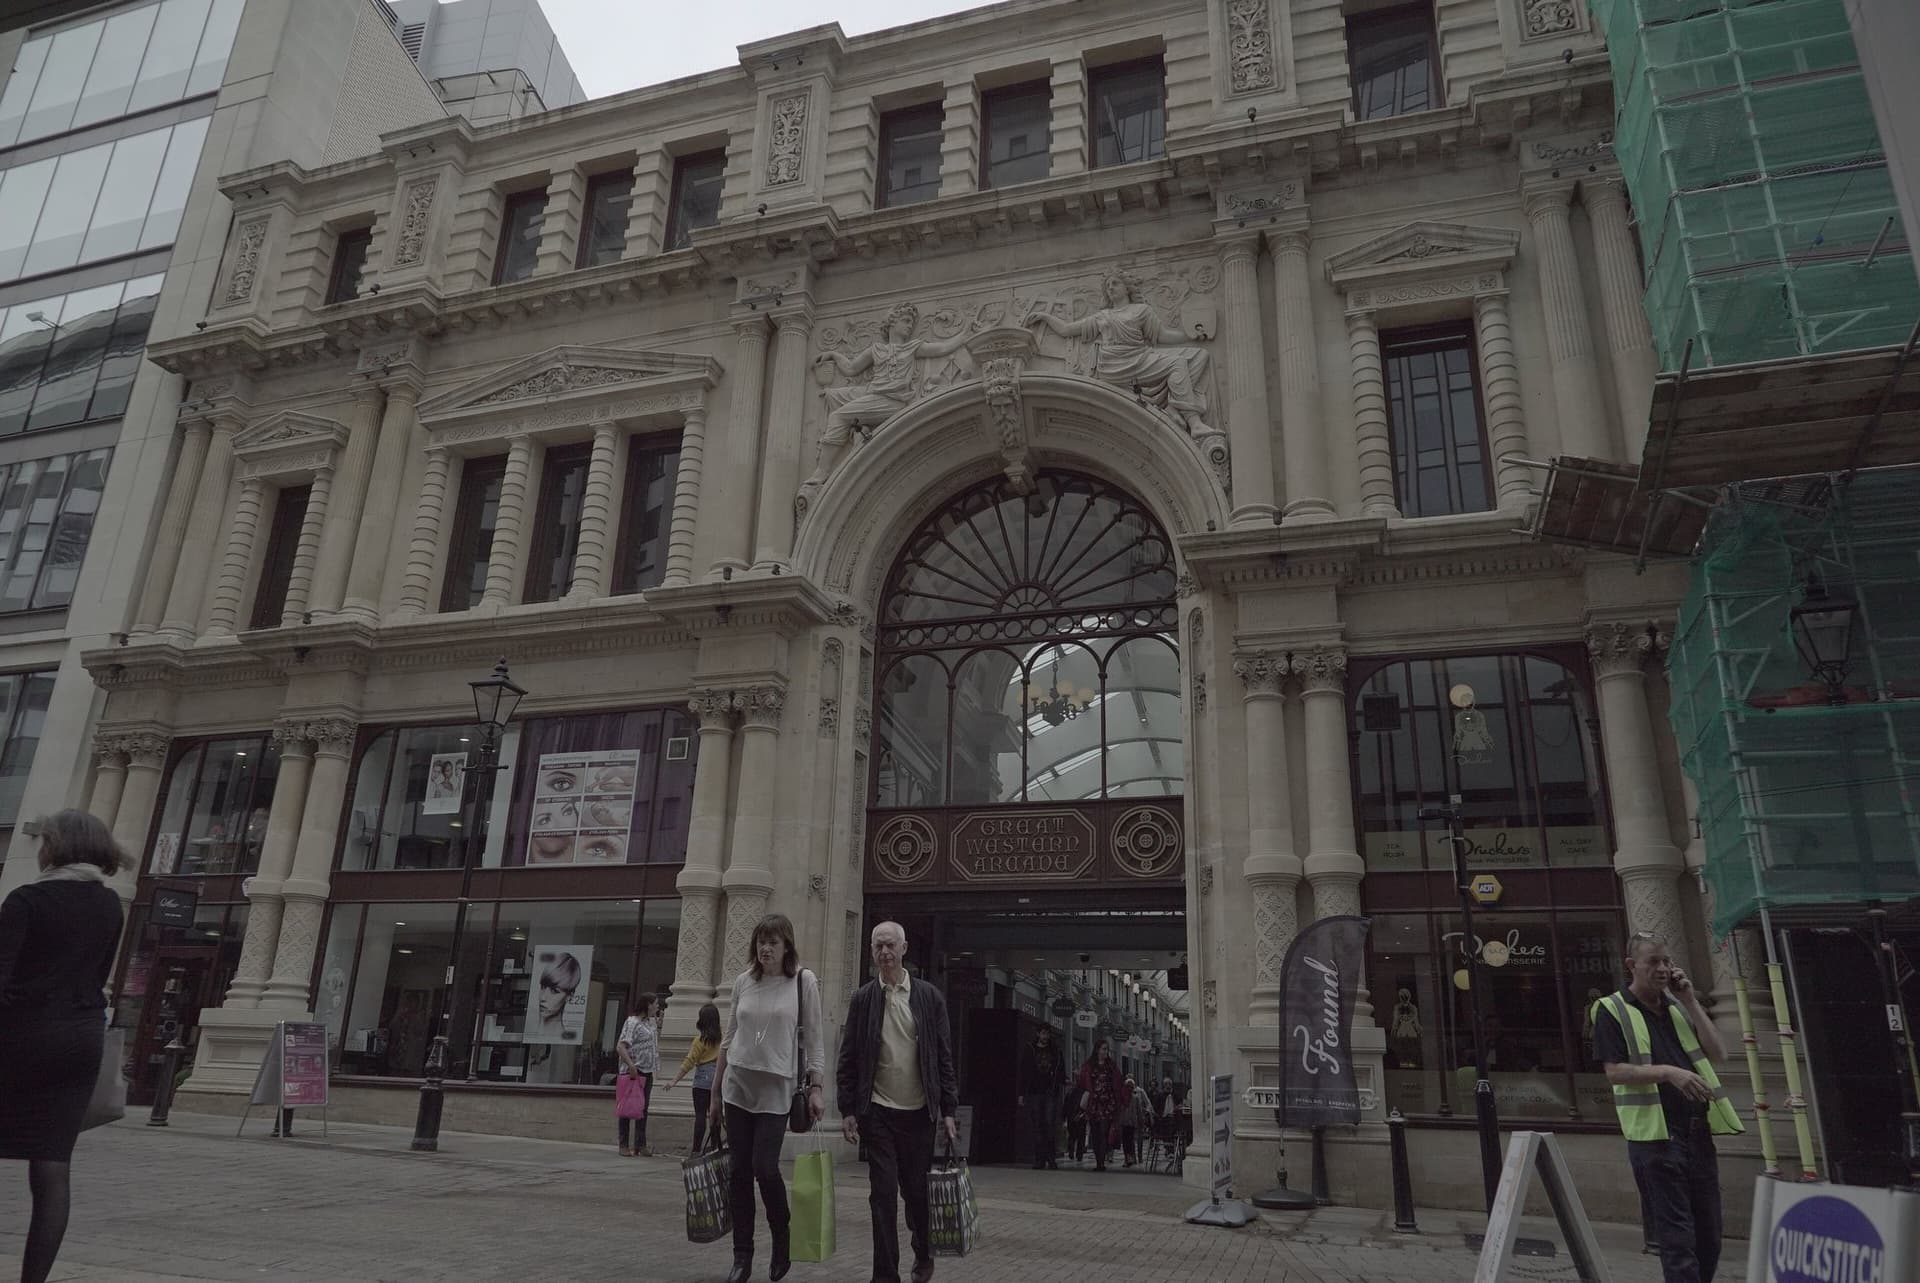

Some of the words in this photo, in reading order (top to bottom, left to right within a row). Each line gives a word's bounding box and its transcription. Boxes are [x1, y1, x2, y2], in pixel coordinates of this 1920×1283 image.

[980, 817, 1064, 836] GREAT
[966, 836, 1080, 855] WESTERN
[975, 855, 1070, 873] ARCADE
[1479, 883, 1495, 893] ADT
[1293, 955, 1340, 1075] Found
[1775, 1226, 1885, 1283] QUICKSTITCH
